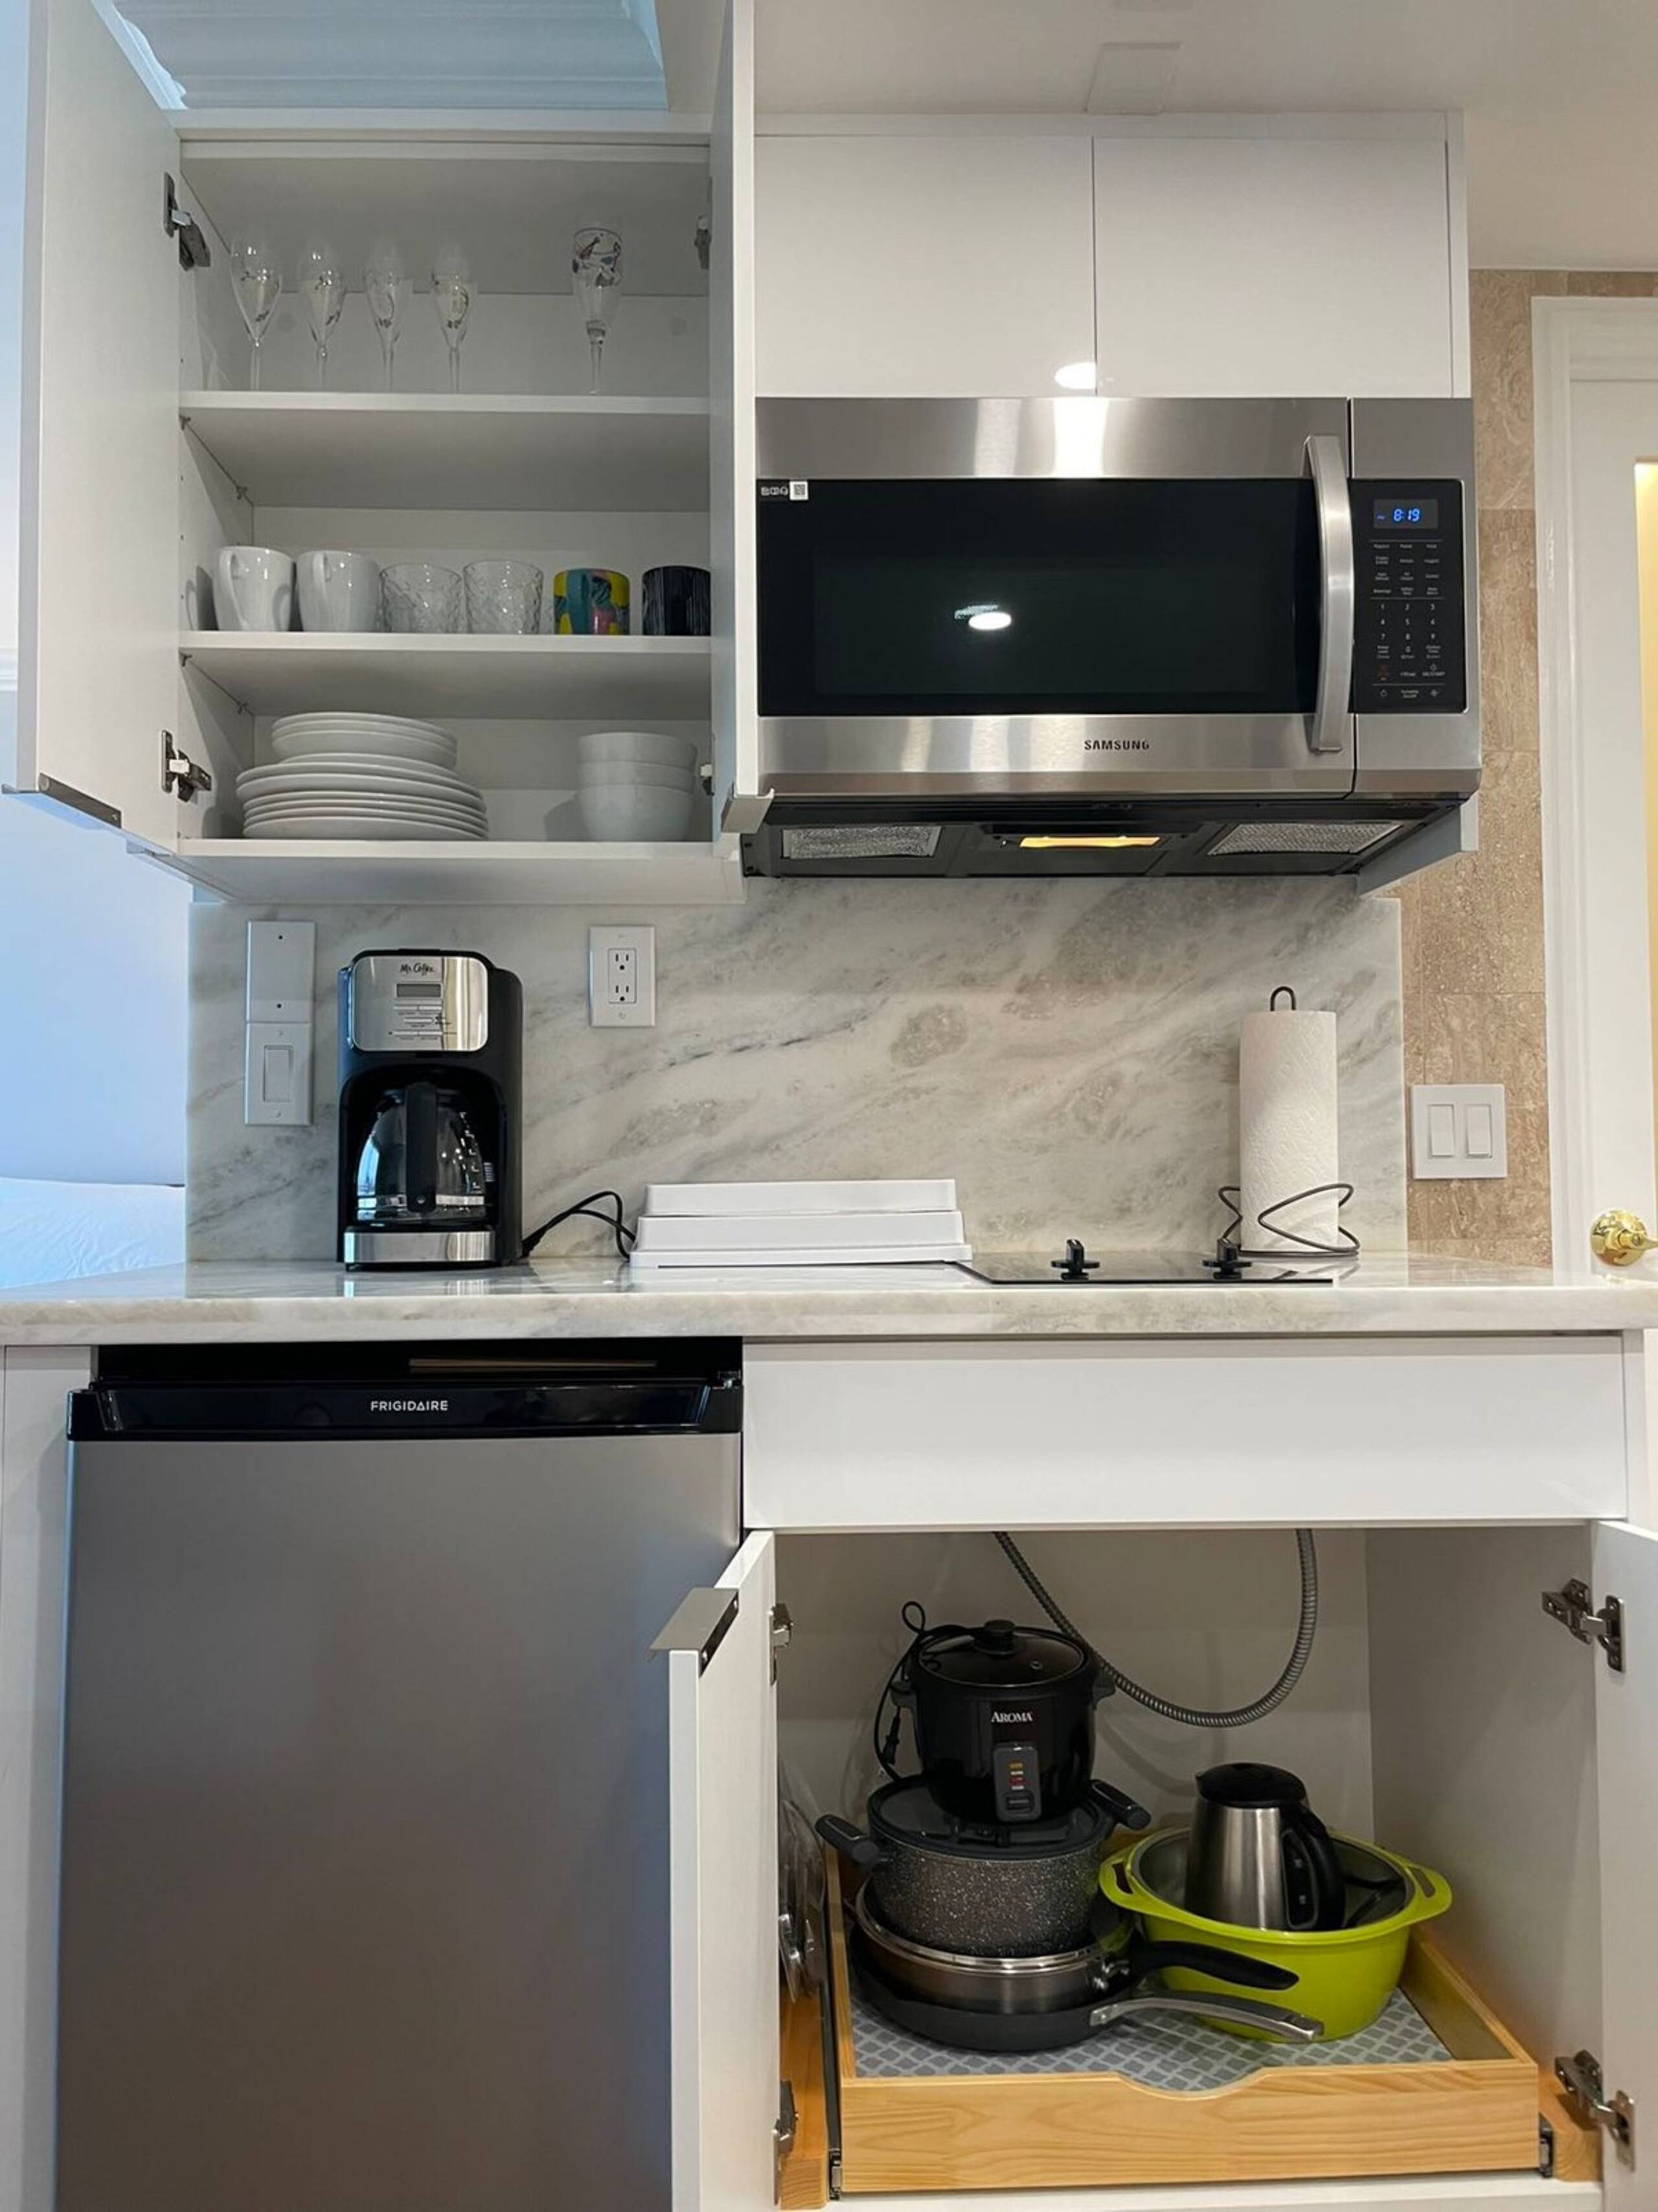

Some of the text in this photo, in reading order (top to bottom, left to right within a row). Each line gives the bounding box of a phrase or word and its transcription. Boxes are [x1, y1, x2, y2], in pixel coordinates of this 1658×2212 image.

[1393, 508, 1420, 521] 8:19
[1084, 740, 1150, 751] SAMSUNG
[370, 1400, 449, 1411] FRIGIDAIRE
[991, 1711, 1034, 1723] AROMA
